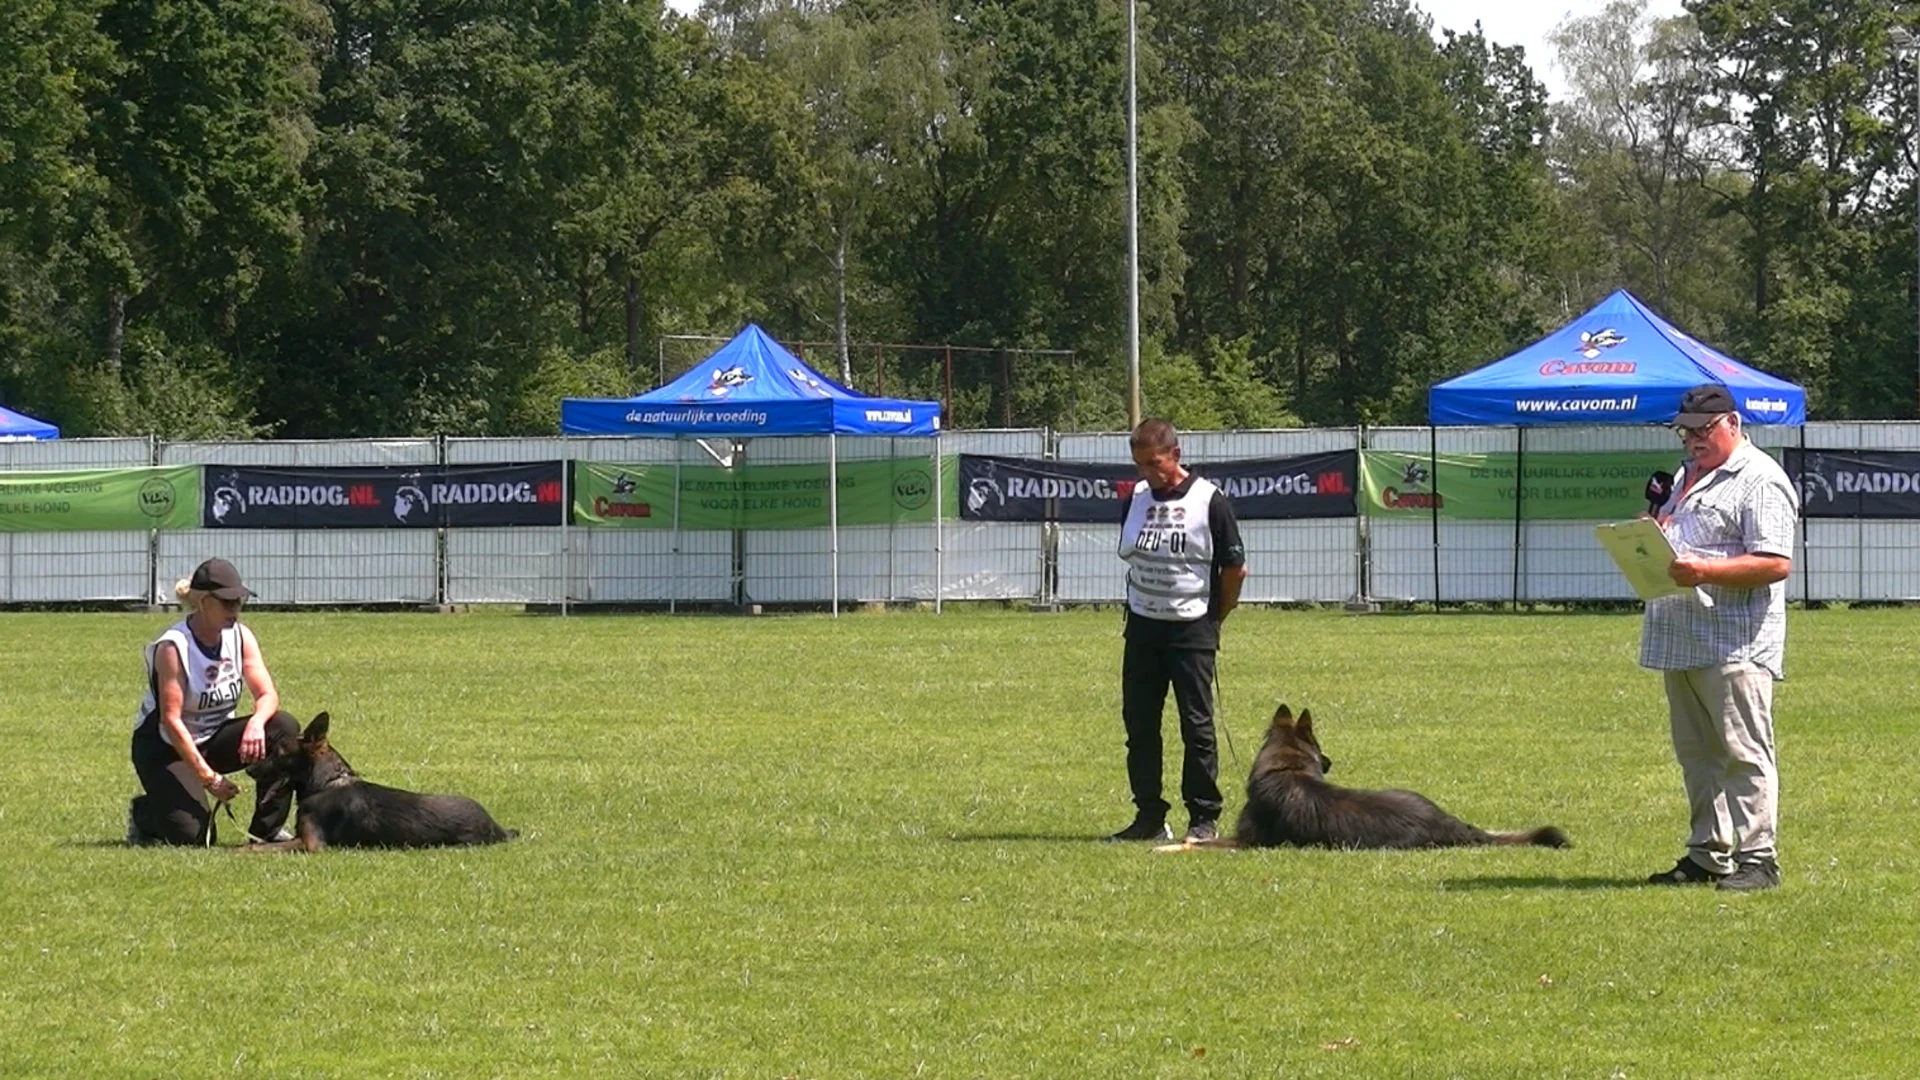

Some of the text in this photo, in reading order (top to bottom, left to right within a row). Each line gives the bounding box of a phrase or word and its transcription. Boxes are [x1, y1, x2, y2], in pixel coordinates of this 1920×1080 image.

[1538, 360, 1637, 376] Cavom
[1516, 395, 1637, 412] www.cavom.nl
[625, 408, 767, 425] de natuurlijke voeding
[1470, 468, 1490, 479] DE
[697, 479, 790, 493] NATUURLIJKE
[1544, 487, 1581, 499] ELKE
[1586, 486, 1629, 499] HOND
[248, 484, 380, 507] RADDOG.NL
[34, 501, 71, 513] HOND
[701, 497, 821, 510] VOOR ELKE HOND
[1135, 530, 1186, 553] DEU-01
